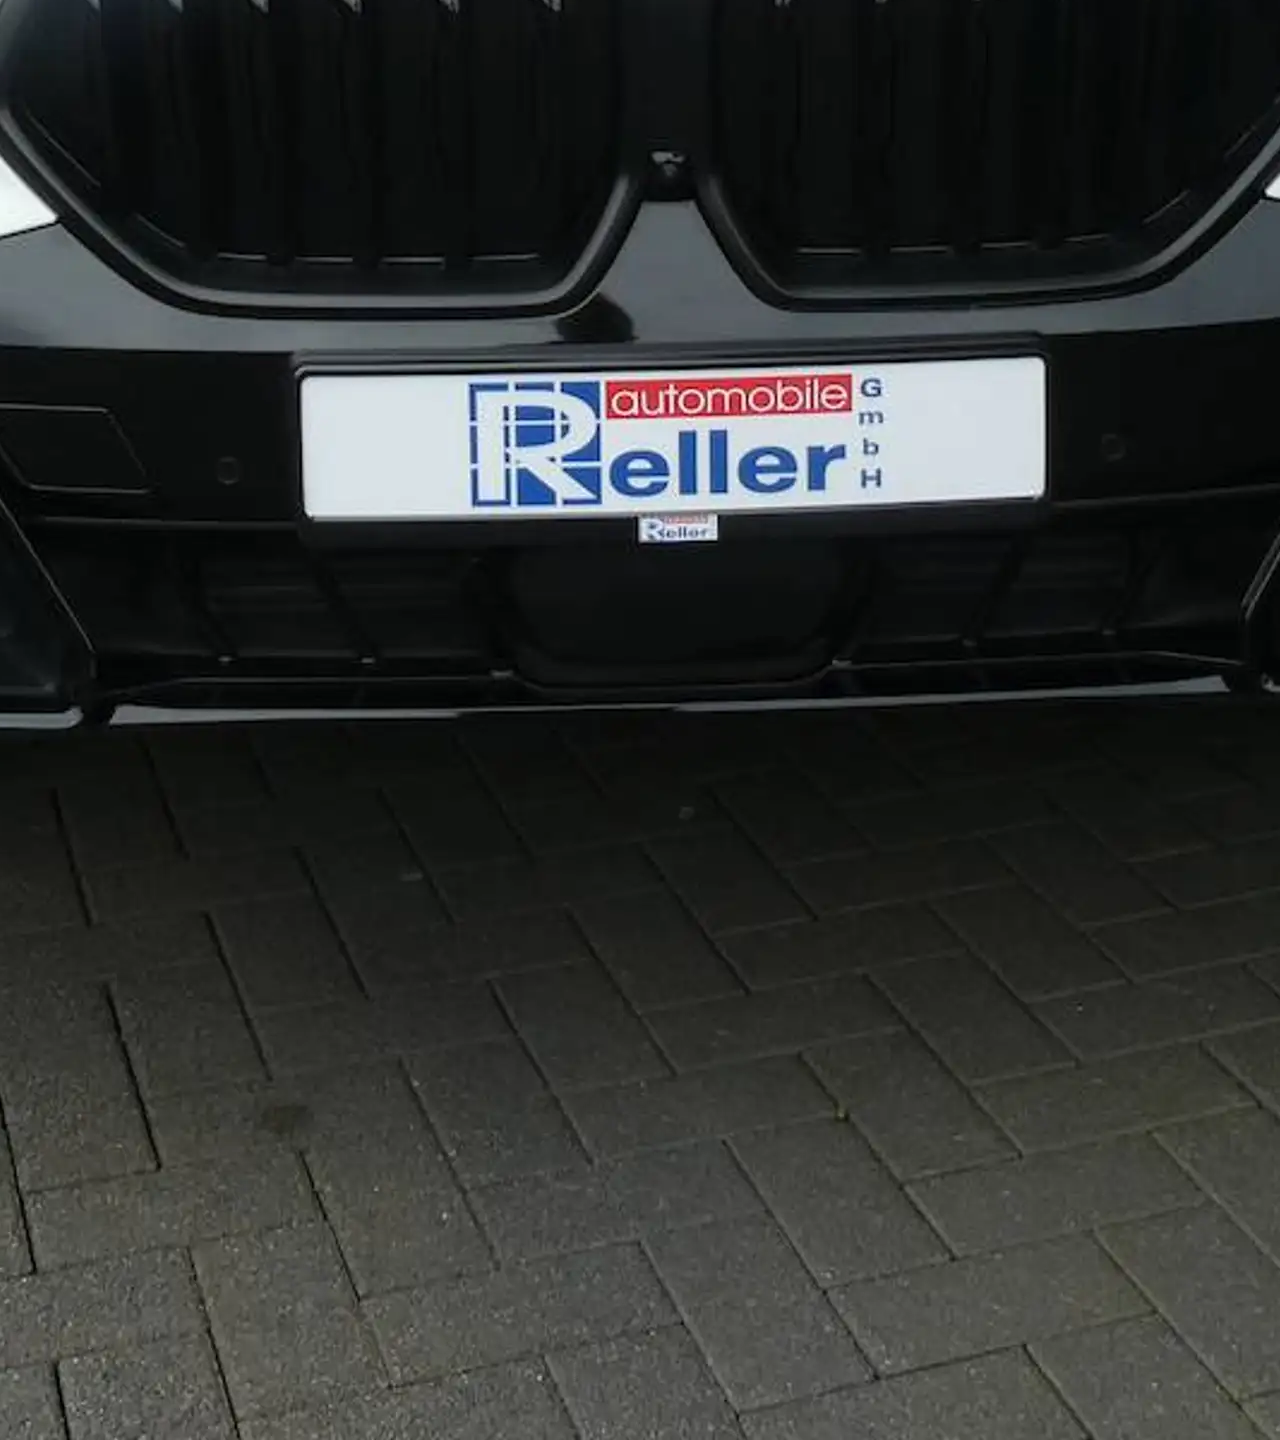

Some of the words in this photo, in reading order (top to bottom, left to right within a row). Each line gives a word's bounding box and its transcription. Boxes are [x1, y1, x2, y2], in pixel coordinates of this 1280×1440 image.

[472, 382, 848, 505] Reller
[609, 375, 849, 417] automobile
[858, 378, 884, 489] GmbH
